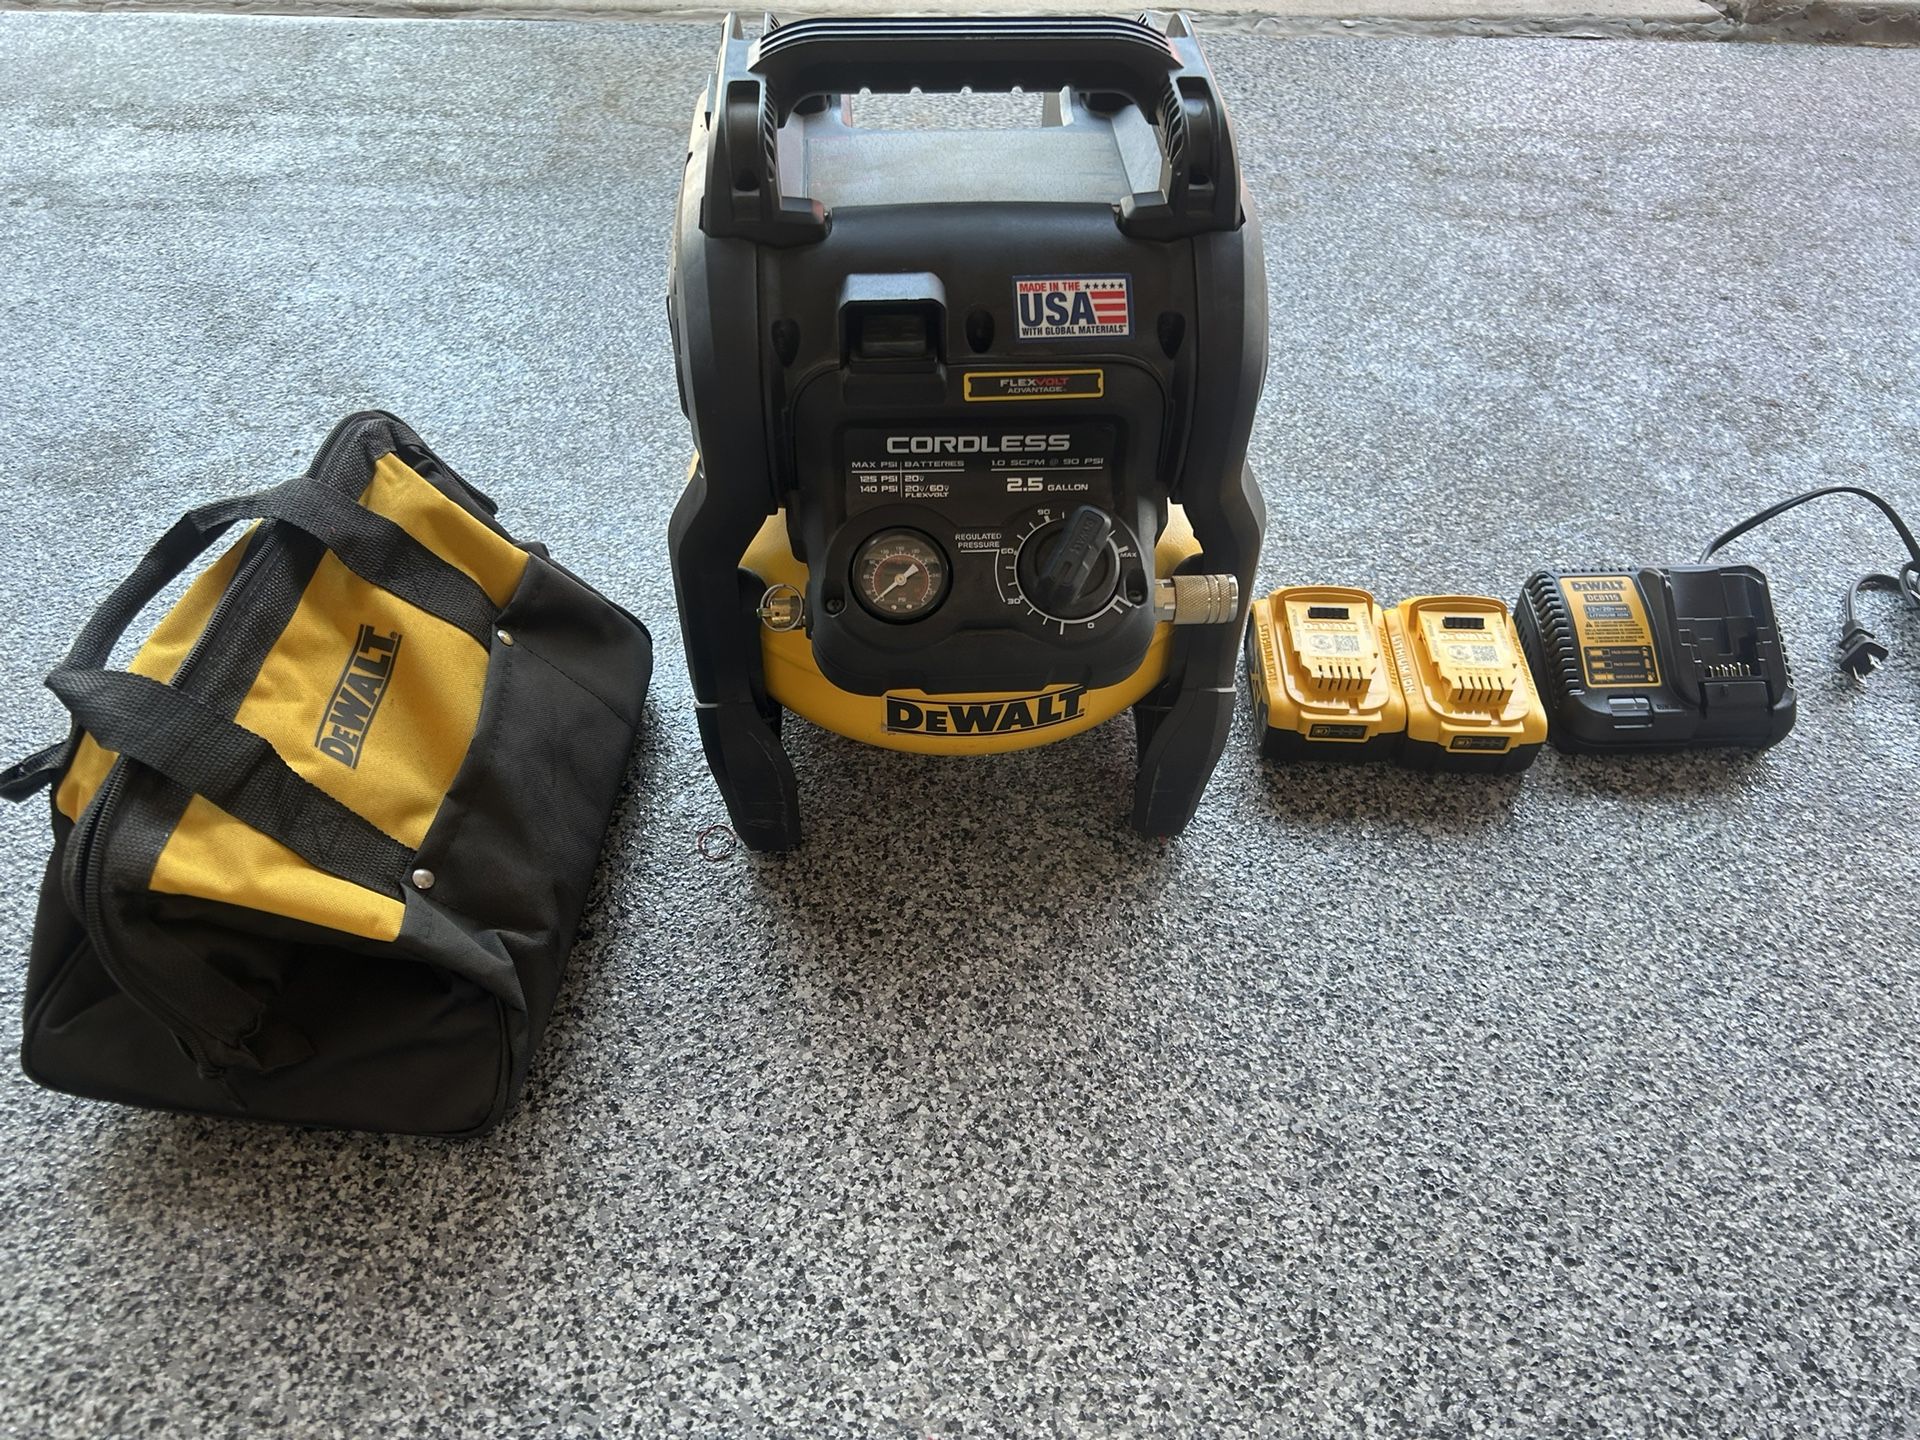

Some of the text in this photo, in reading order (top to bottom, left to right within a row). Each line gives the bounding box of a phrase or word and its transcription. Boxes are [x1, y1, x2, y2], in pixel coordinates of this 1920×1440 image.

[1019, 281, 1080, 292] MADE IN THE
[1020, 291, 1096, 327] USA
[1022, 327, 1043, 336] WITH
[1045, 326, 1076, 335] GLOBAL
[1000, 377, 1069, 387] FLEXVOLT
[886, 434, 1070, 453] CORDLESS
[1084, 457, 1104, 465] PSI
[860, 475, 898, 483] 125 PSI
[860, 485, 898, 493] 140 PSI
[1006, 477, 1089, 492] 2.5 GALLON
[1037, 508, 1051, 516] 90
[955, 532, 1002, 542] REGULATED
[957, 541, 1000, 550] PRESSURE
[1001, 547, 1014, 555] 60
[1087, 622, 1095, 630] 0
[1391, 632, 1416, 694] LITHIUM ION
